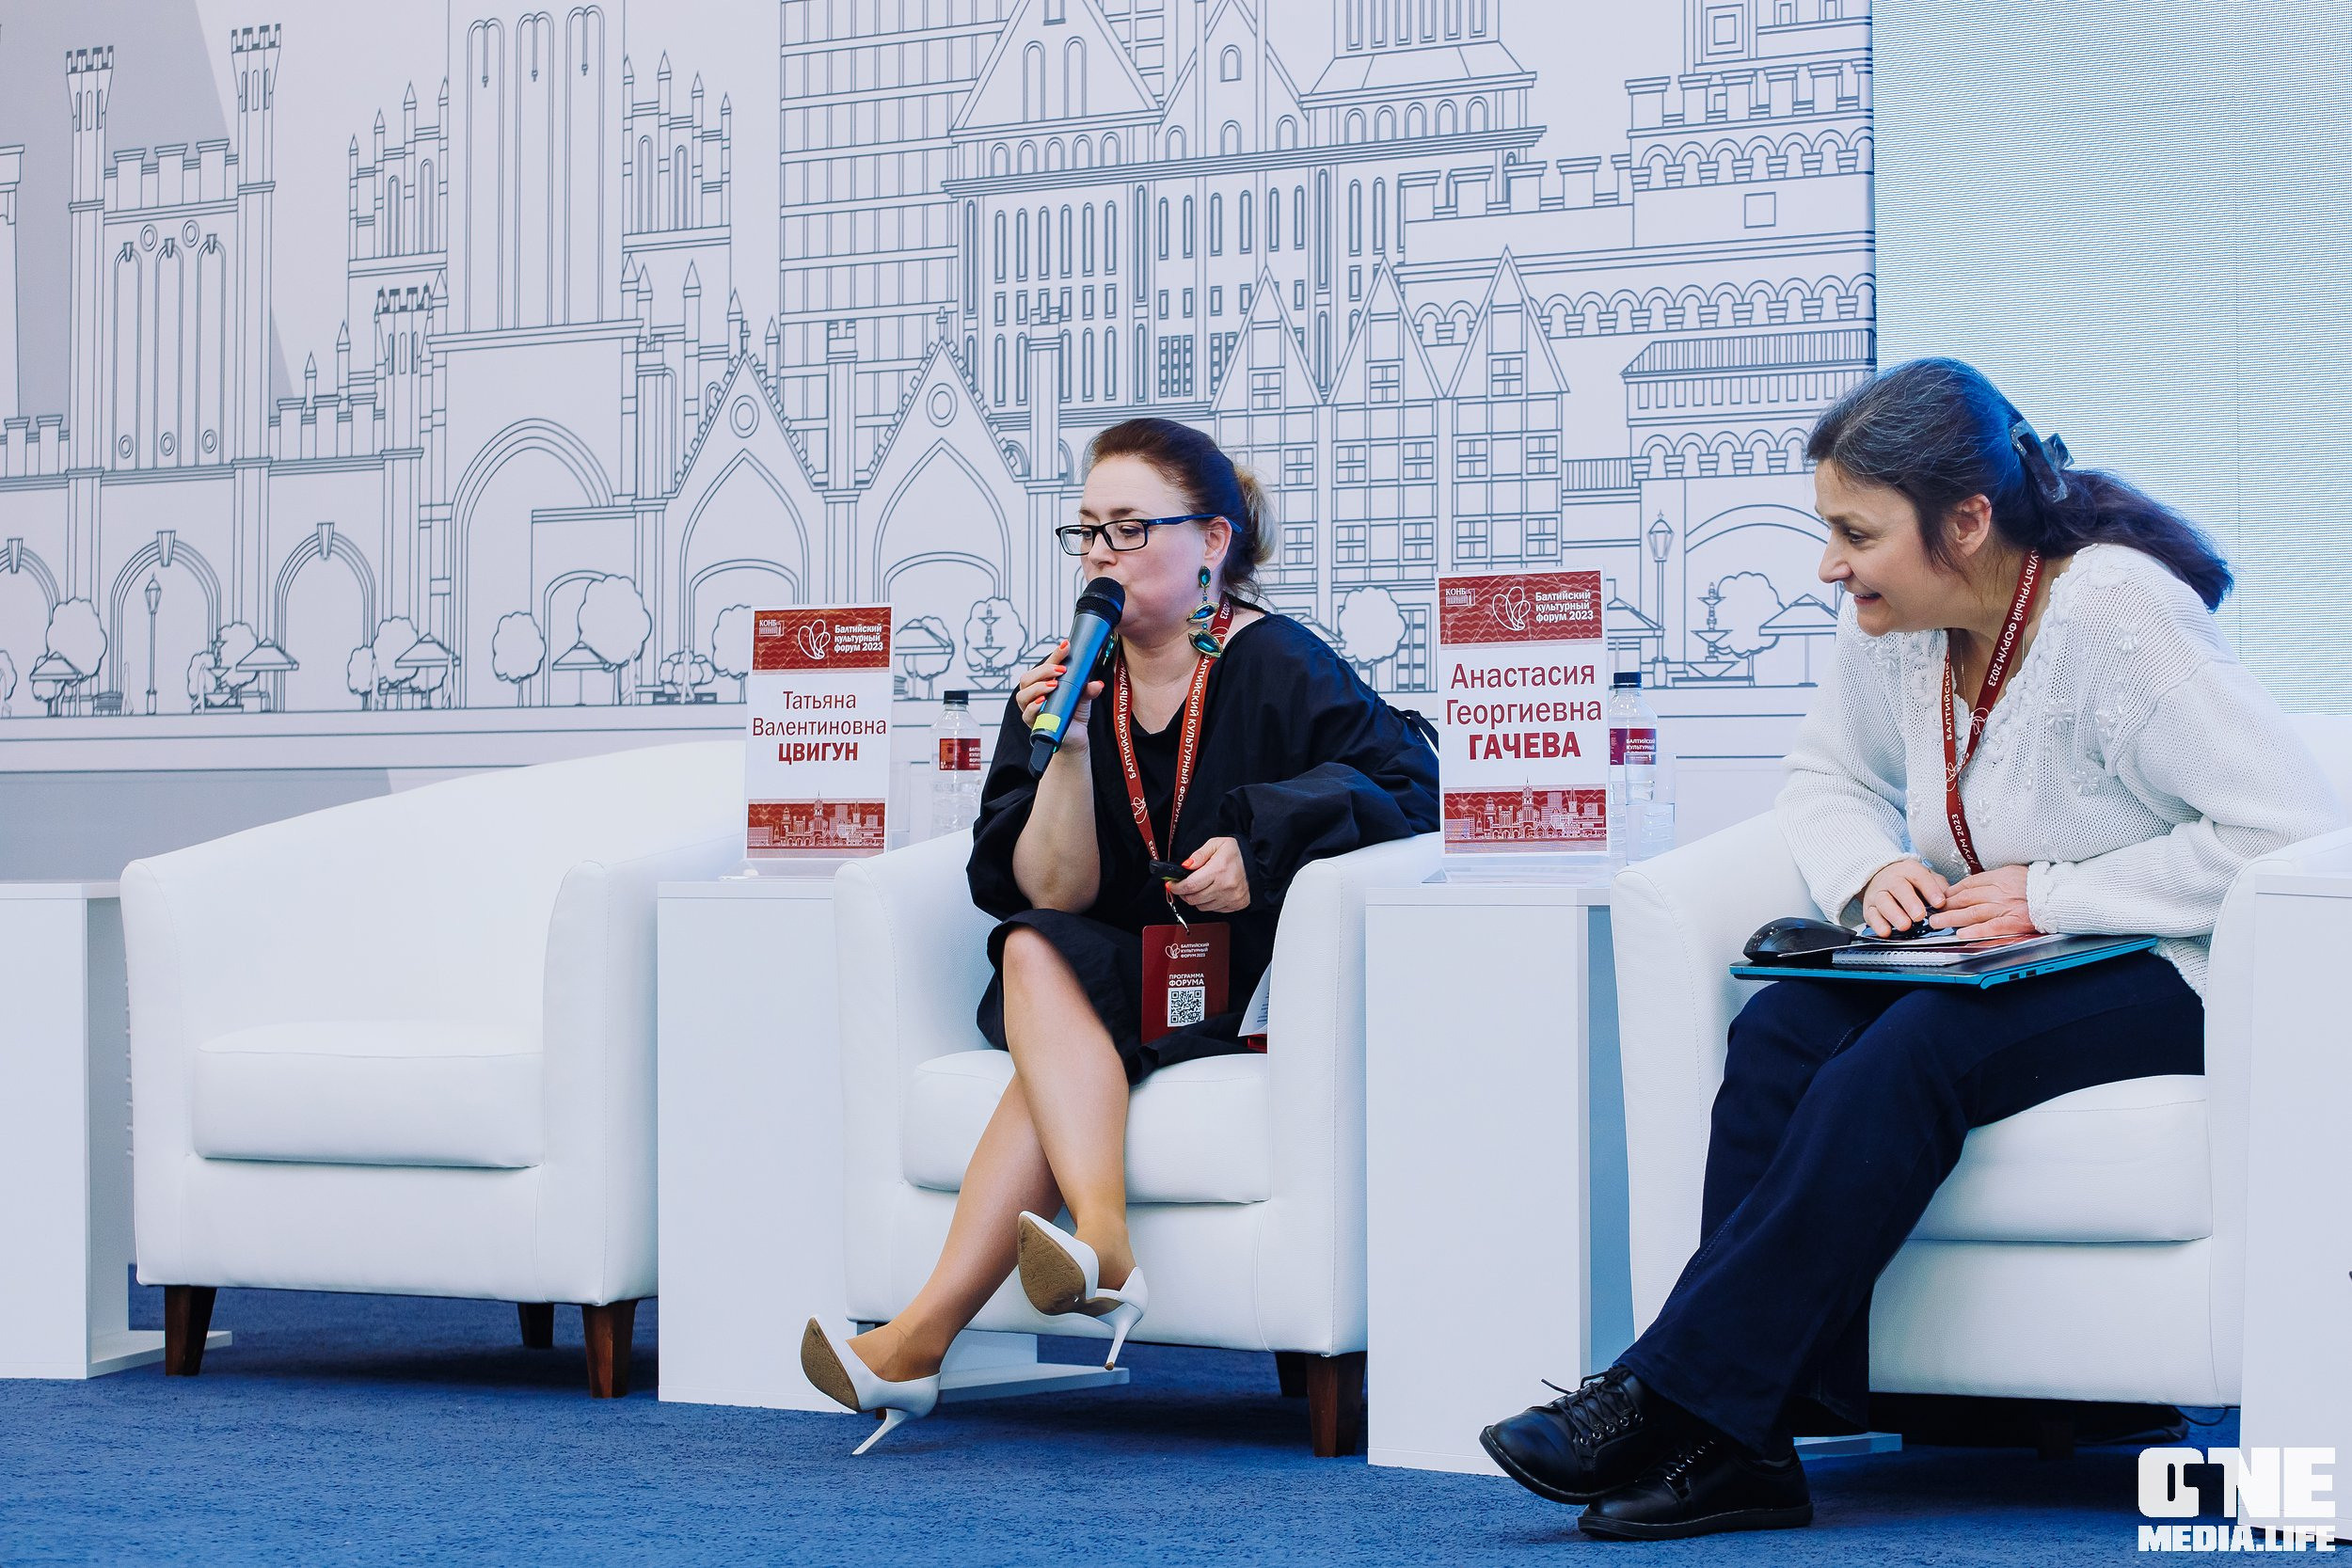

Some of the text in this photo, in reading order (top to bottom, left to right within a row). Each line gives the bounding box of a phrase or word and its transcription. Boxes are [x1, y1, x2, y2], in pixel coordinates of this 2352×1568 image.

[1535, 590, 1591, 601] Балтийский
[1535, 600, 1590, 612] культурный
[1535, 610, 1594, 624] форум 2023
[834, 624, 882, 633] Балтийский
[834, 632, 881, 644] культурный
[834, 641, 883, 653] форум 2023
[1996, 622, 2017, 663] ФОРУМ
[1451, 663, 1596, 689] Анастасия
[1988, 663, 2003, 687] 2023
[783, 690, 856, 709] Татьяна
[1118, 663, 1136, 780] БАЛТИЙСКИЙ КУЛЬТУРН
[1446, 700, 1602, 729] Георгиевна
[753, 718, 886, 736] Валентиновна
[778, 742, 859, 765] ЦВИГУН
[1181, 718, 1197, 784] КУЛЬТУРНЫЙ
[1469, 731, 1581, 760] ГАЧЕВА
[1951, 814, 1964, 837] 2023
[1168, 978, 1205, 987] ФОРУМА
